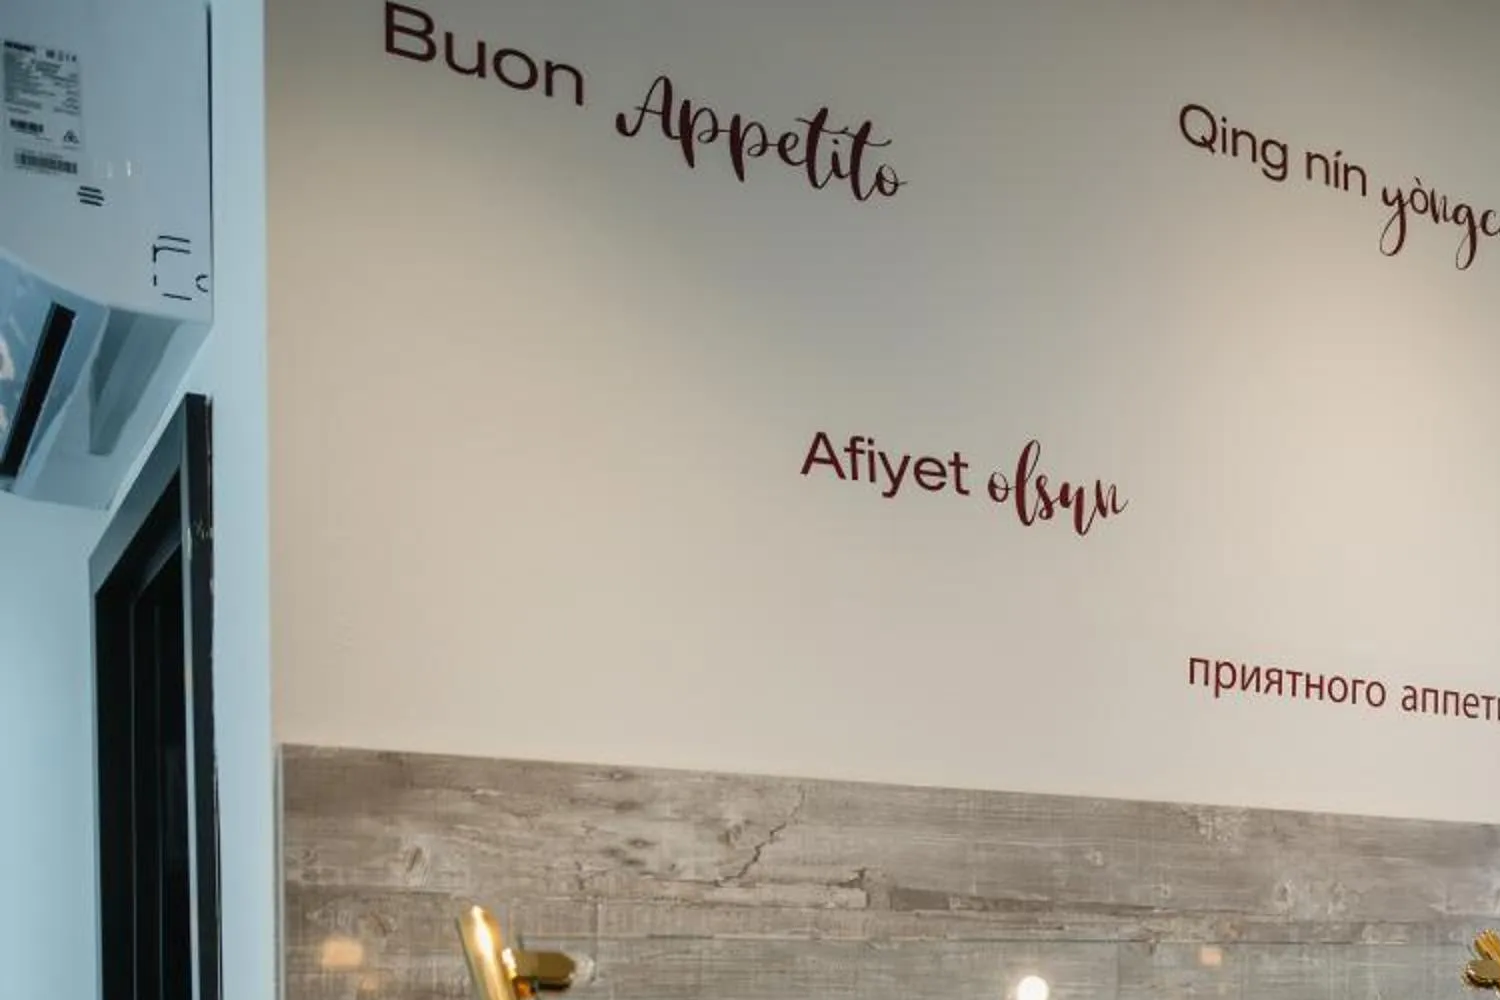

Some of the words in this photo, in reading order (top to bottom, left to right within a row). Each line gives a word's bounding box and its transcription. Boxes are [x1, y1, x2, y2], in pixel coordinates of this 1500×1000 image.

[384, 0, 585, 106] Buon
[614, 75, 908, 201] Appetito
[1178, 103, 1289, 182] Qing
[1304, 149, 1367, 197] nín
[800, 431, 971, 498] Afiyet
[987, 438, 1130, 536] olsun
[1188, 657, 1386, 707] приятного
